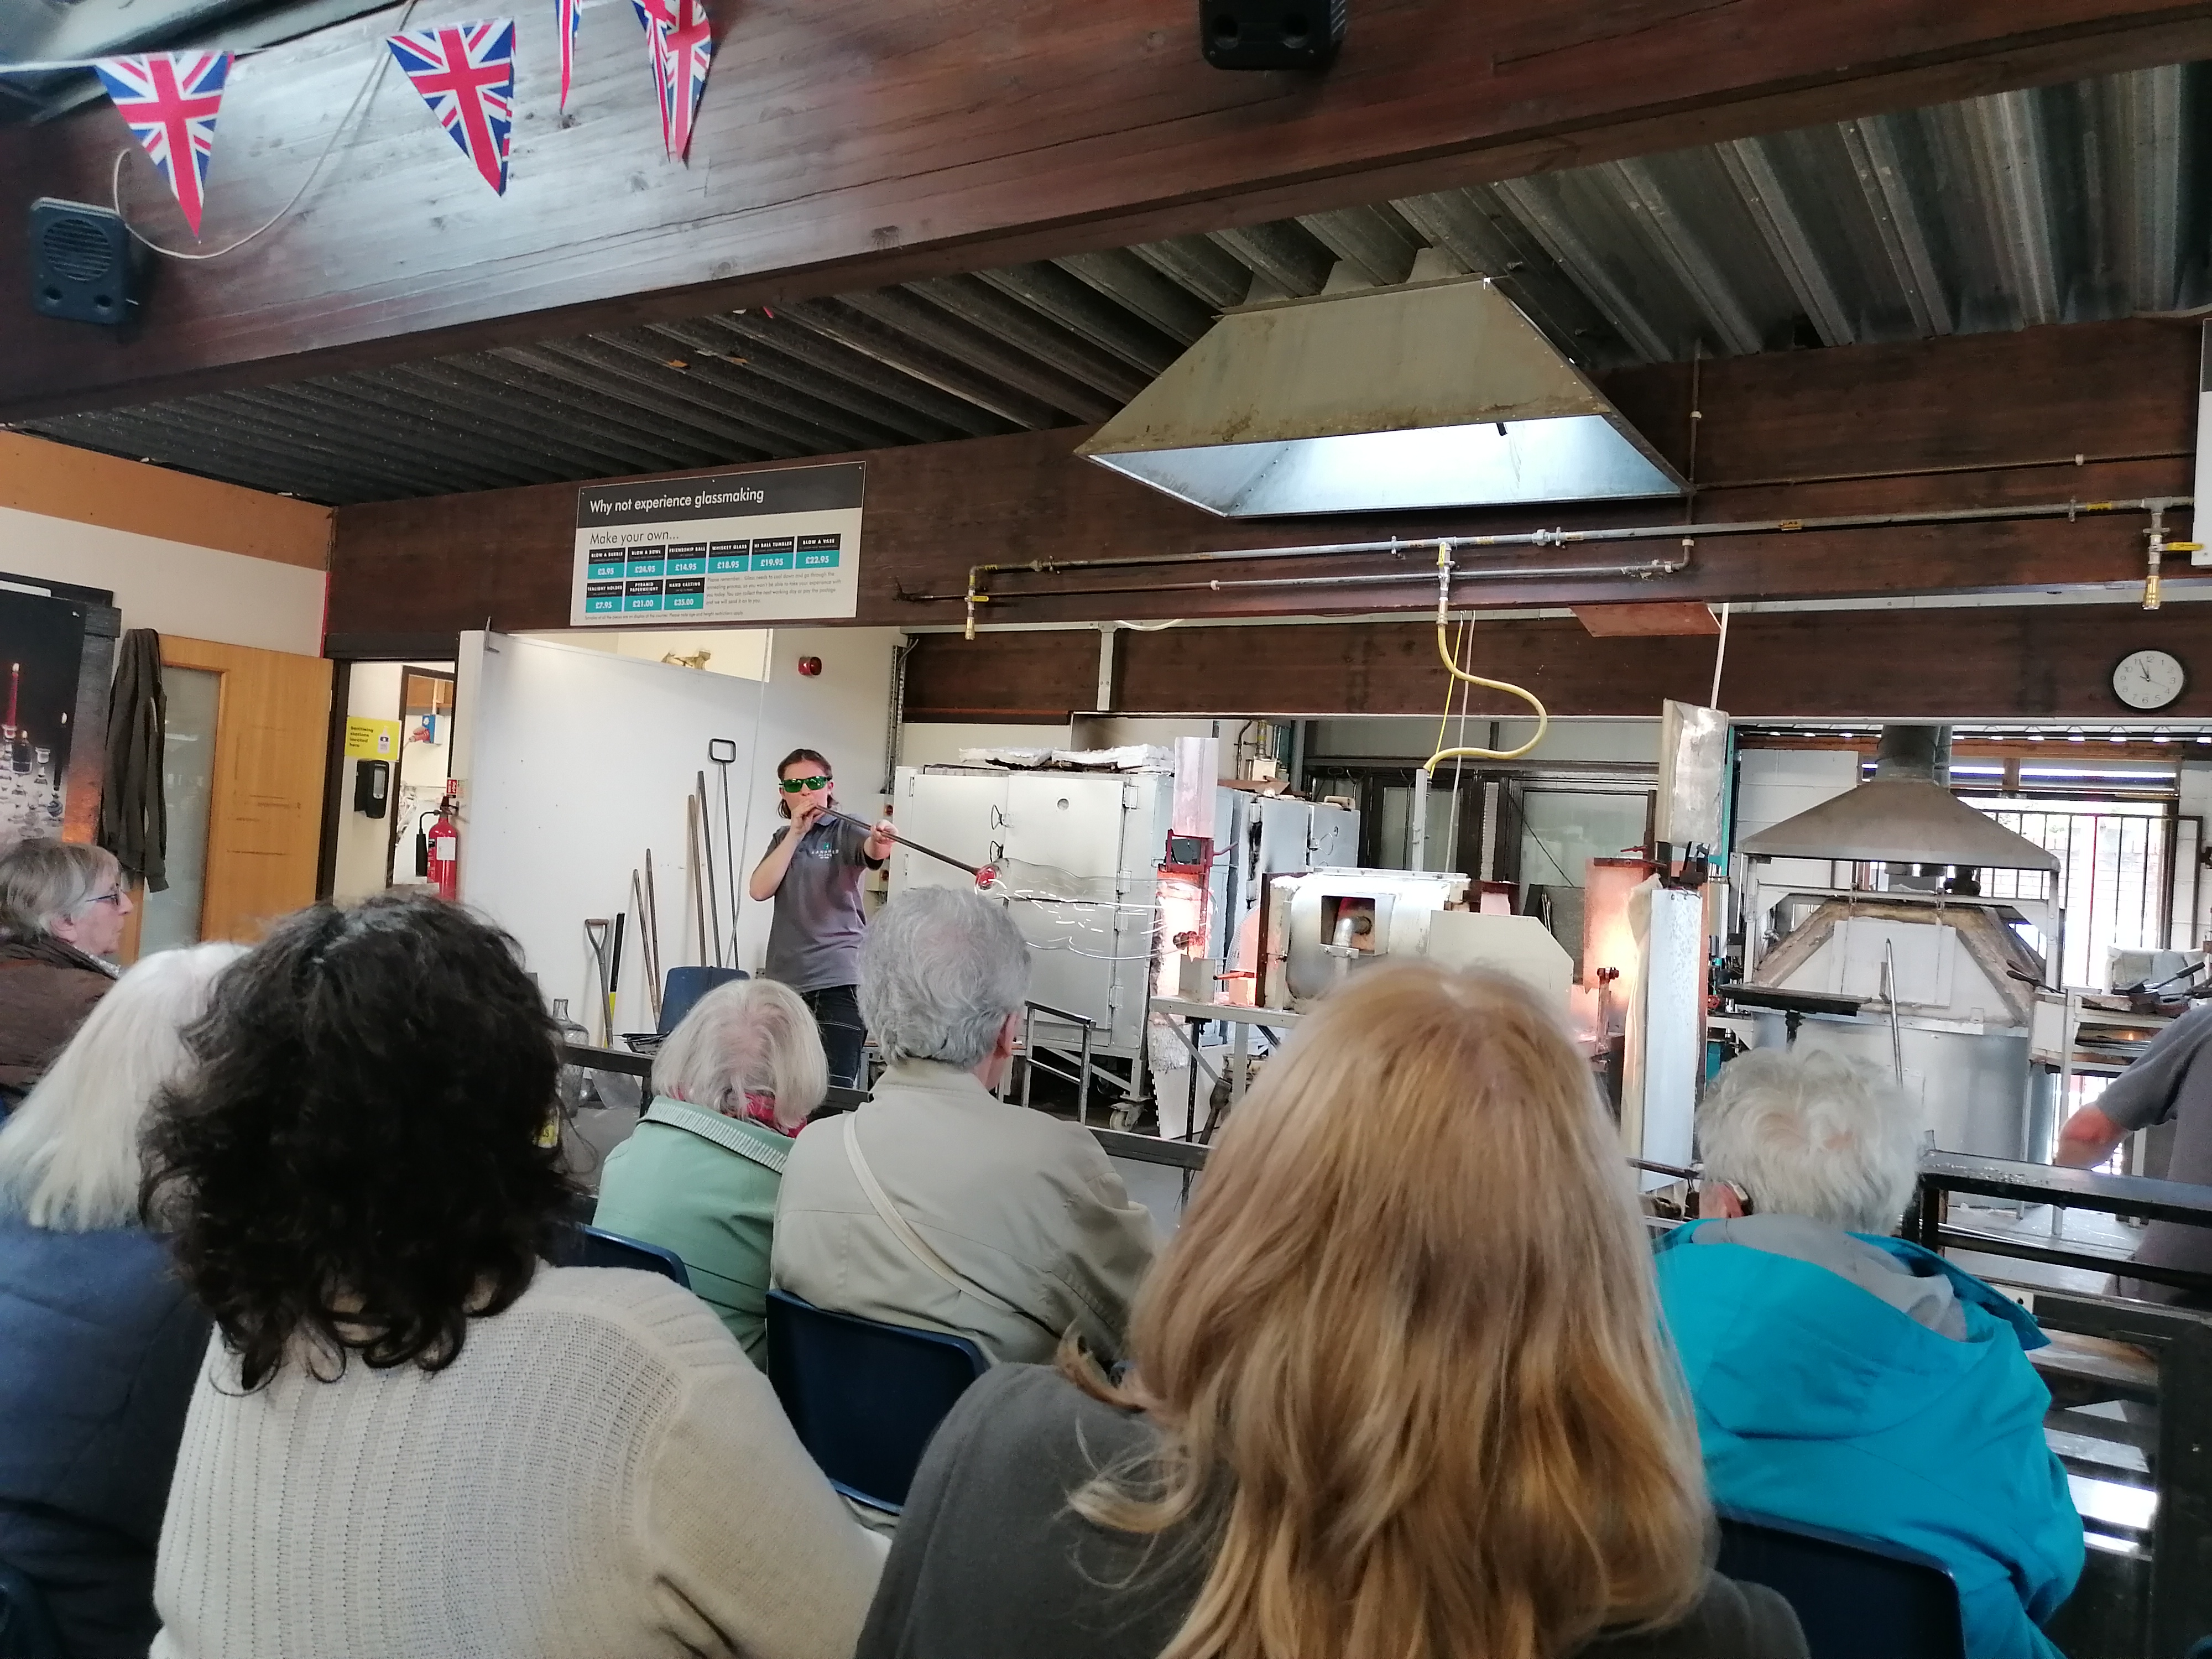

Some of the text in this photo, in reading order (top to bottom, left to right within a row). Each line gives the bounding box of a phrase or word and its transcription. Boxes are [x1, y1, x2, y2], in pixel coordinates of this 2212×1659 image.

[590, 487, 764, 515] Why not experience glassmaking
[590, 531, 679, 546] Make your own...
[760, 559, 784, 567] £19.95
[805, 556, 830, 564] £22.95
